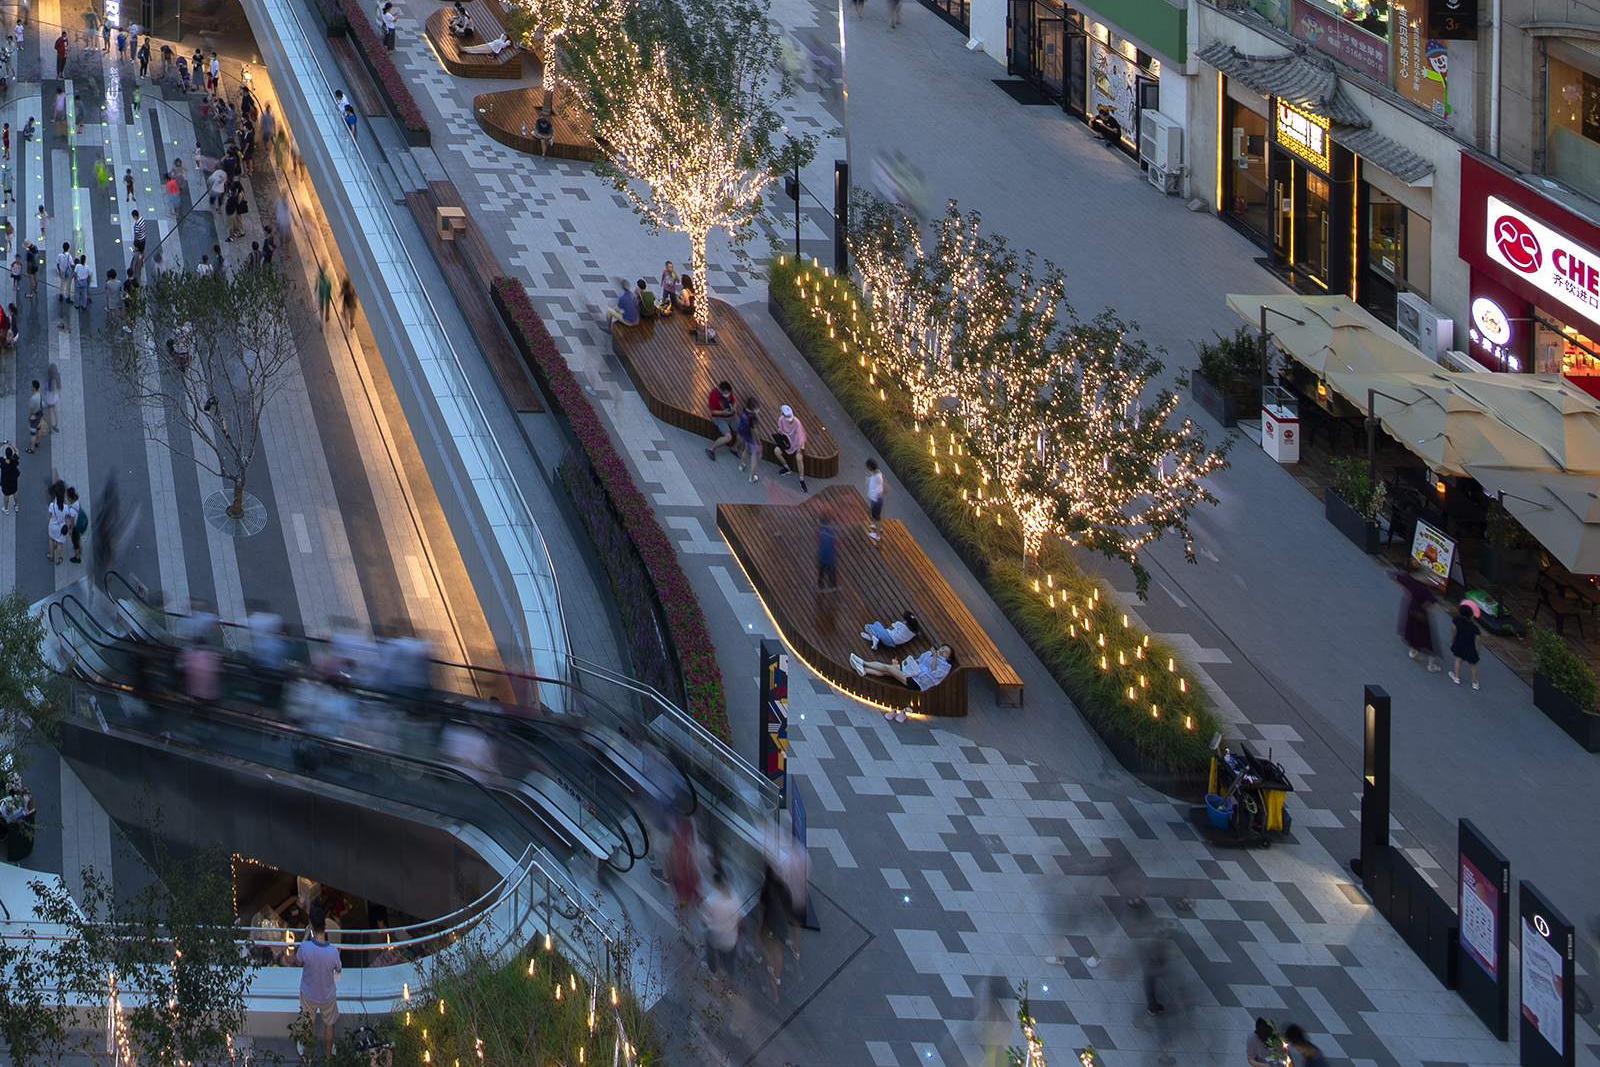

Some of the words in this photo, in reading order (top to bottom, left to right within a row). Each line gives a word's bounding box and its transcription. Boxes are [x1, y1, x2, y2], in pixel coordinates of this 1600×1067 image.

[1445, 18, 1461, 31] 3F
[1552, 273, 1599, 310] 齐饮进口
